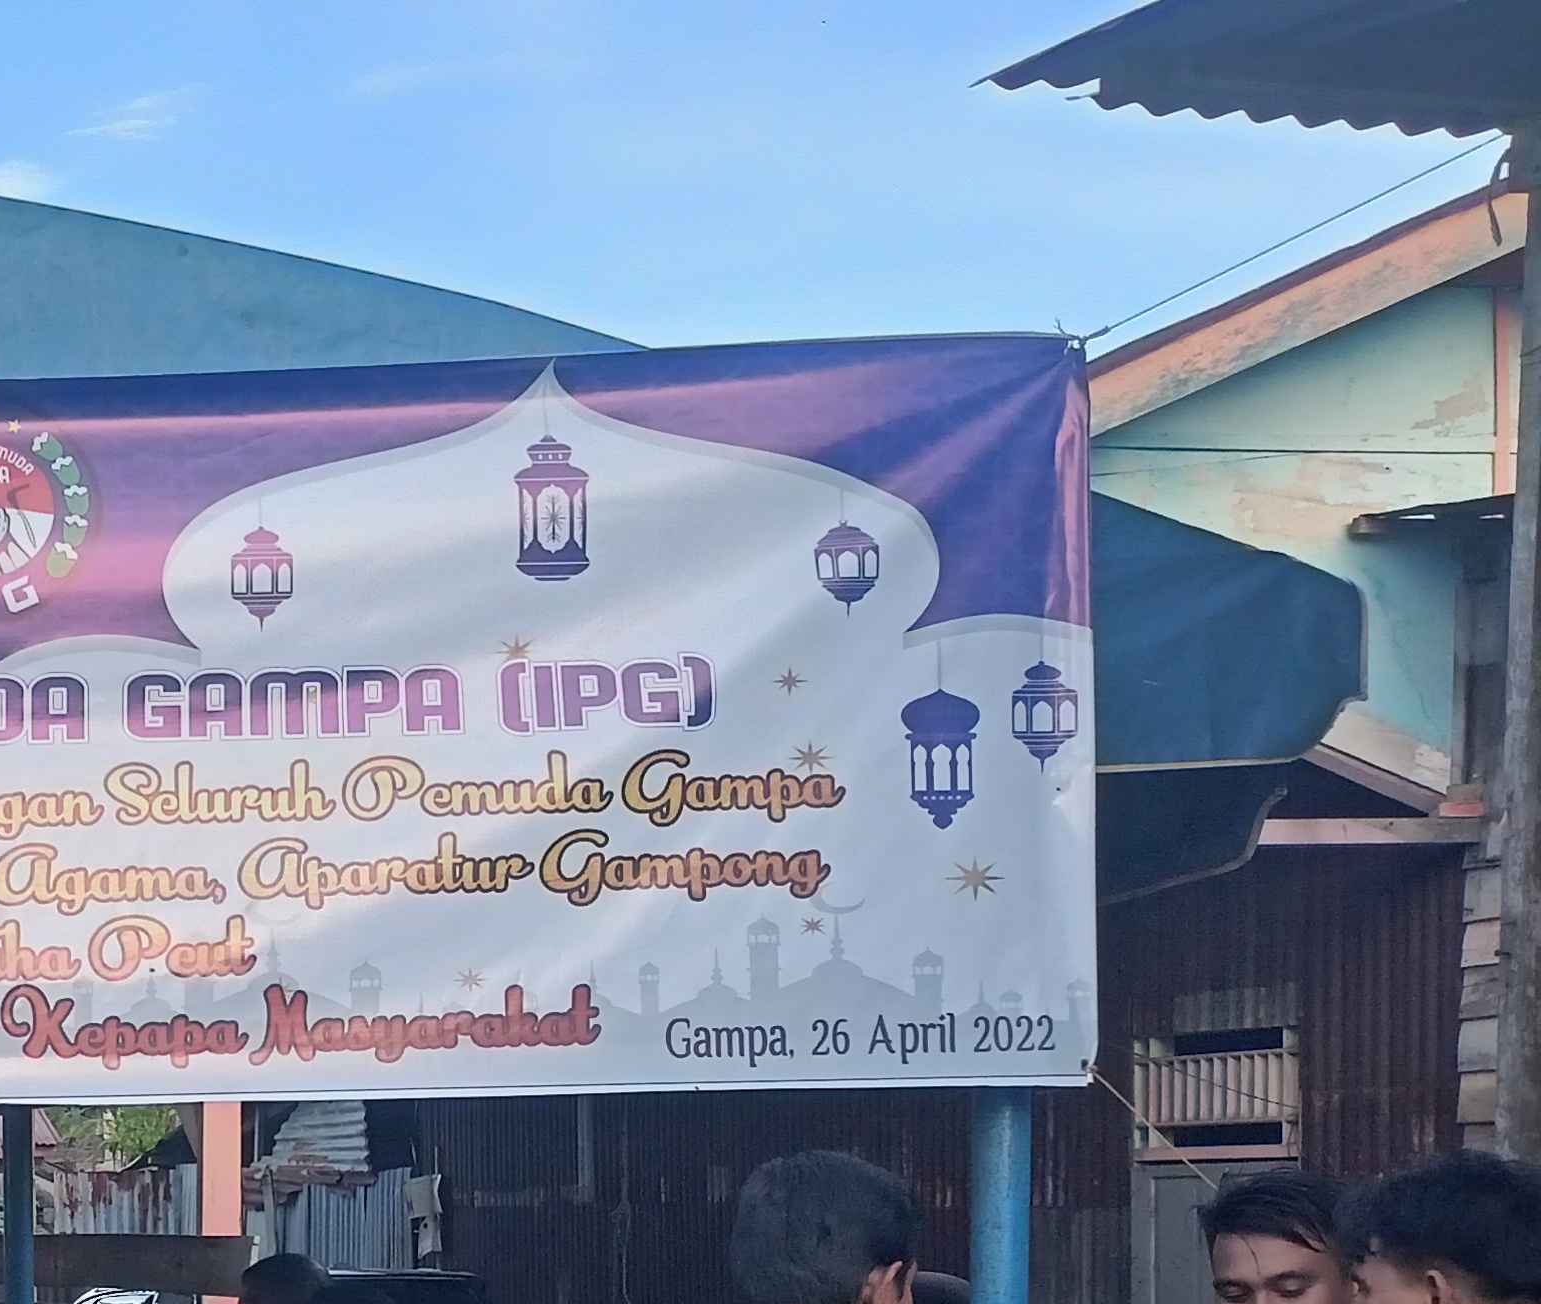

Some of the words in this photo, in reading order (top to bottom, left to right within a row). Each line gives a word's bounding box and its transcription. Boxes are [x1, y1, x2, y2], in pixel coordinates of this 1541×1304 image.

[122, 663, 465, 742] GAMPA
[497, 653, 716, 736] (IPG)
[103, 759, 336, 825] Seluruh
[342, 750, 614, 822] Pemuda
[622, 749, 845, 827] Gampa
[237, 831, 534, 910] Aparatur
[540, 828, 831, 907] Gampong
[88, 914, 257, 981] Peut
[1, 984, 249, 1070] Kepapa
[248, 983, 601, 1065] Masyarakat
[665, 1017, 794, 1067] Gampa,
[811, 1018, 850, 1055] 26
[867, 1013, 957, 1064] April
[972, 1015, 1055, 1052] 2022
